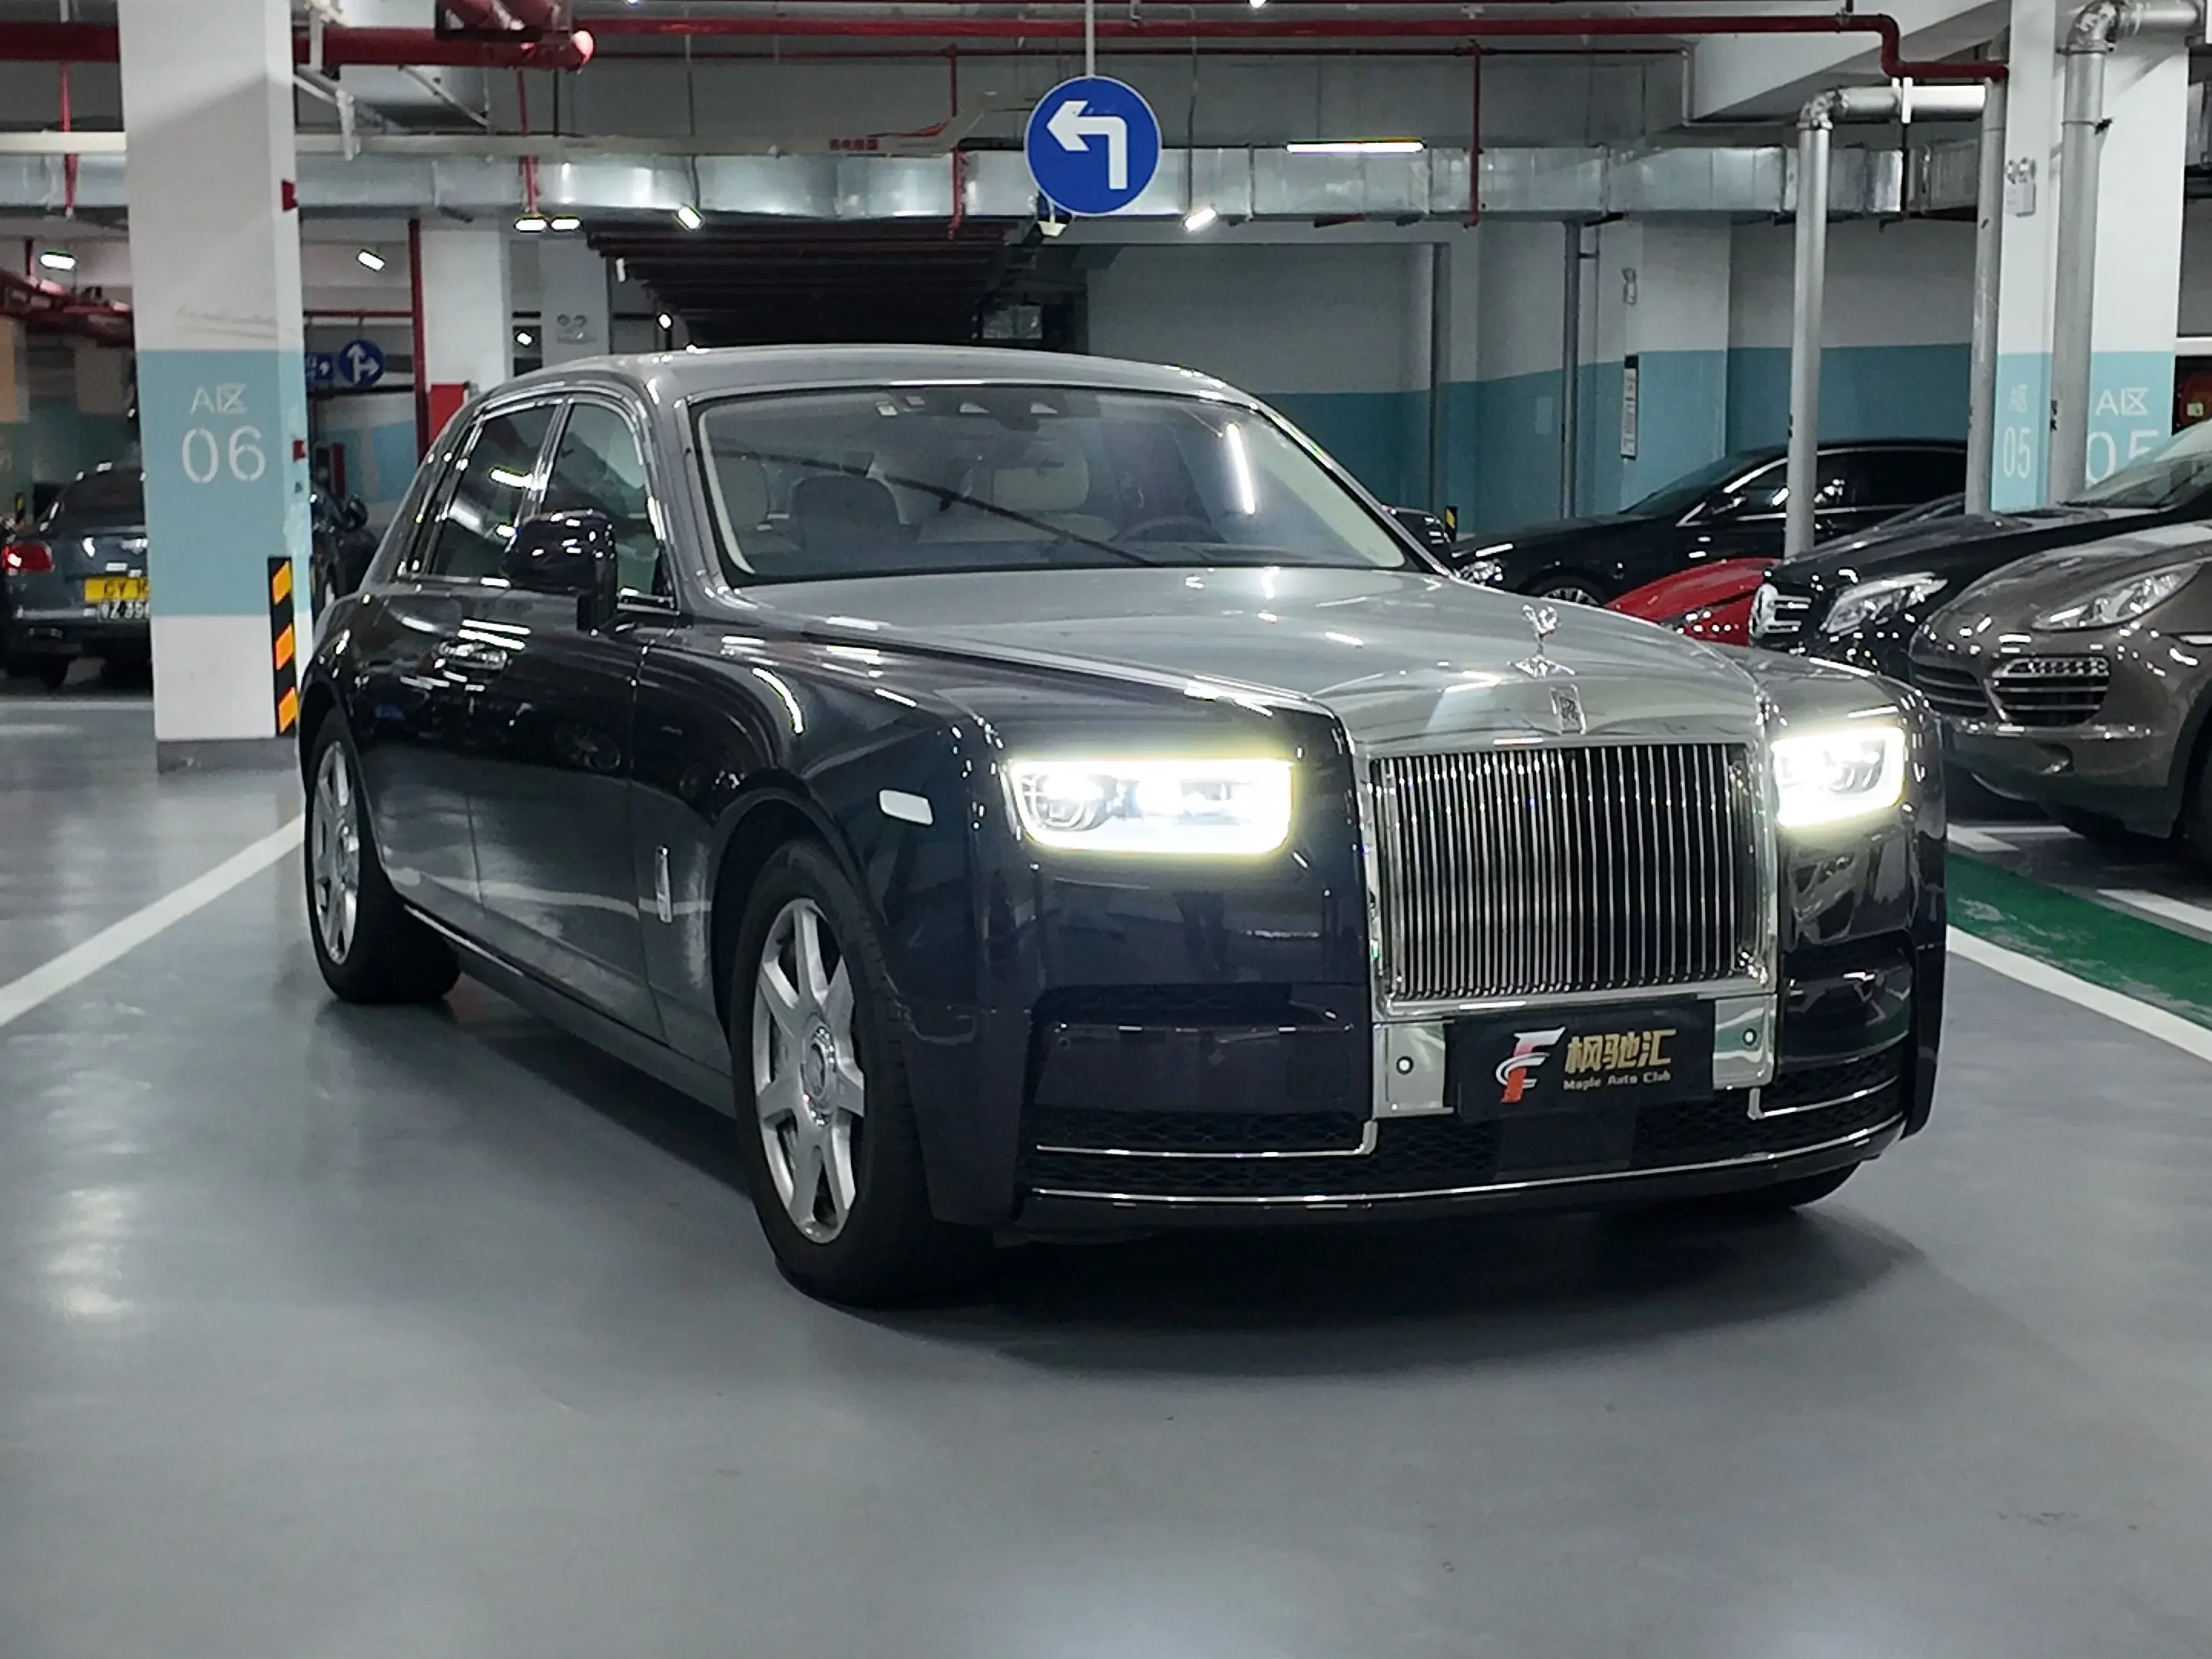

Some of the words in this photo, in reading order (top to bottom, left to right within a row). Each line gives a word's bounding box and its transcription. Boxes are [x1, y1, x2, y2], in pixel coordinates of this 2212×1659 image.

[189, 382, 247, 415] A区
[2095, 386, 2149, 416] A区
[182, 425, 266, 483] 06
[2003, 426, 2032, 479] 05
[1565, 1028, 1677, 1074] 枫驰汇
[1563, 1076, 1601, 1091] Maple
[1608, 1074, 1638, 1085] Auto
[1643, 1070, 1671, 1084] Club
